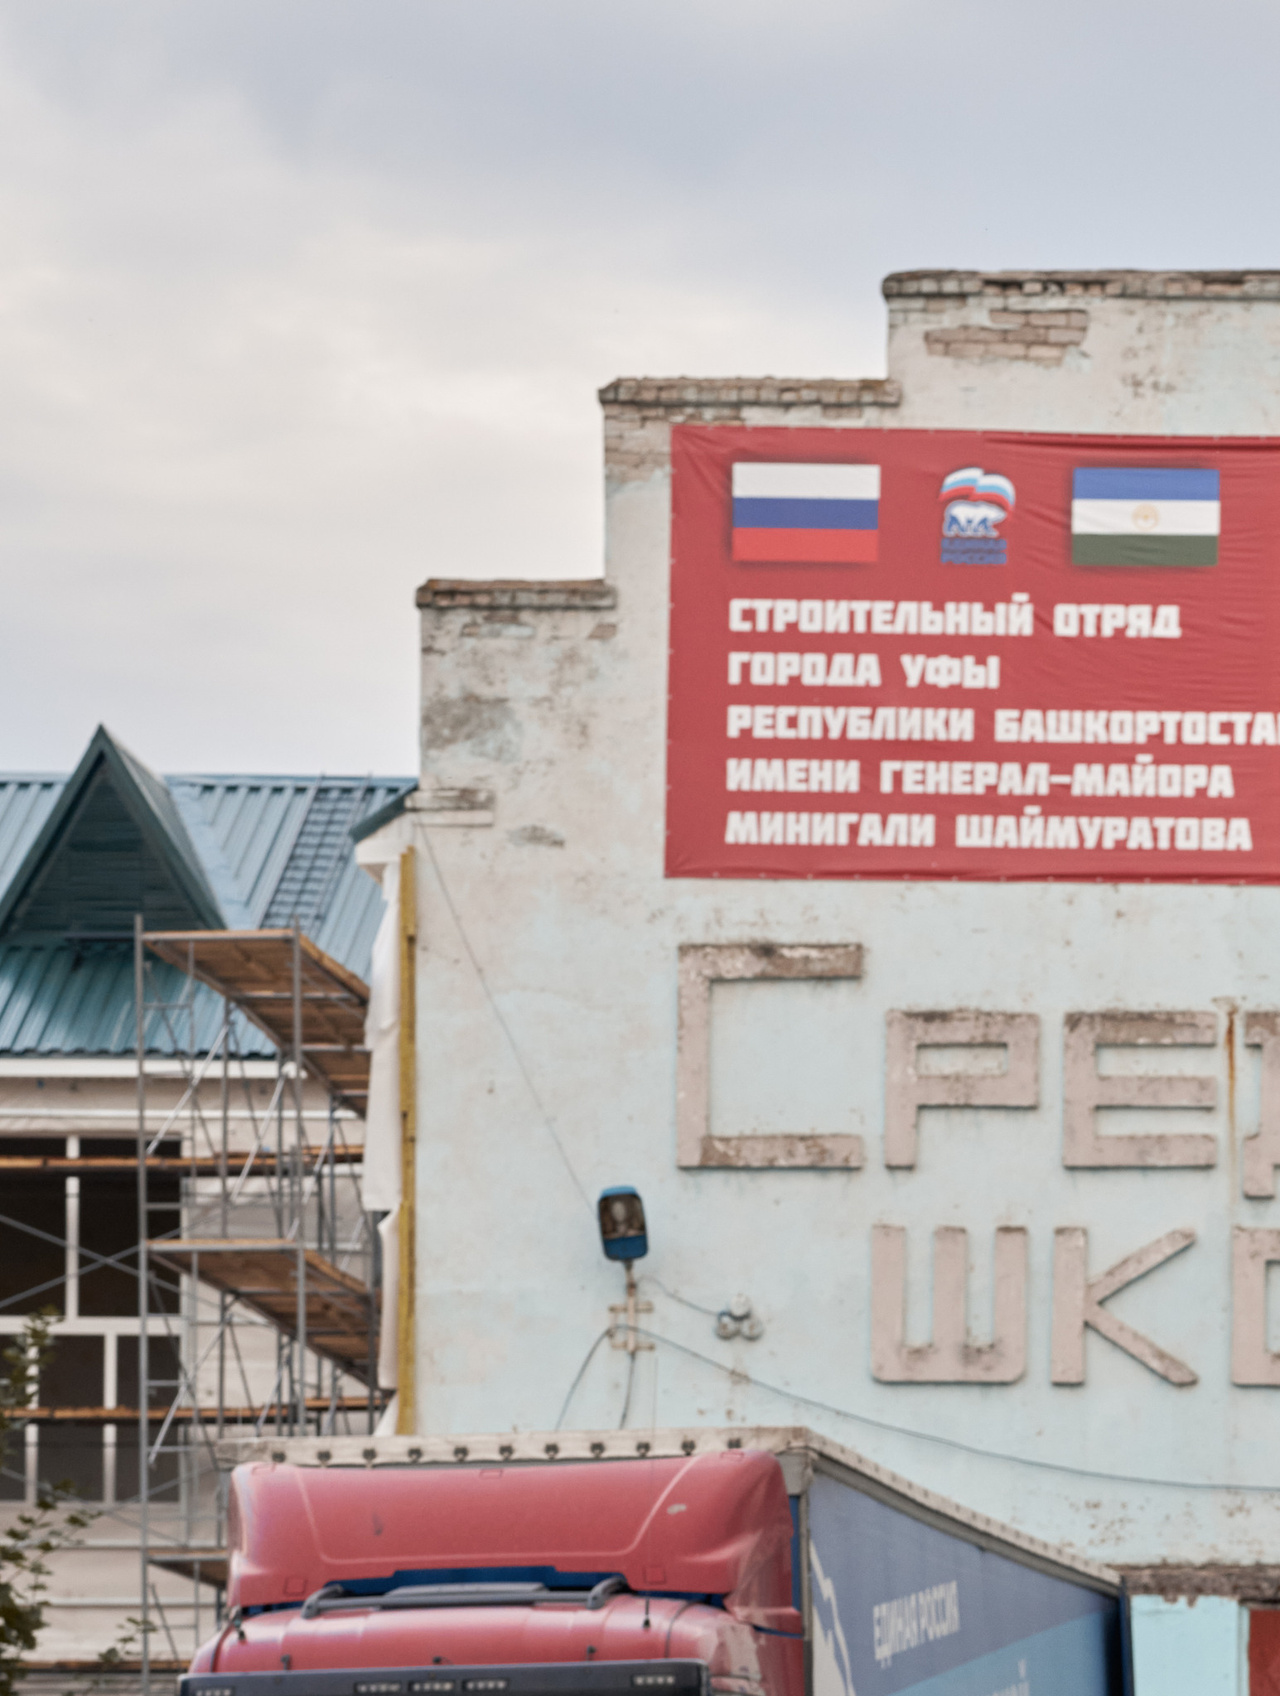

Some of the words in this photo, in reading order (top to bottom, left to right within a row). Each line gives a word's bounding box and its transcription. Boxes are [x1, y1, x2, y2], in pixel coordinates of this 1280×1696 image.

[729, 593, 1033, 637] СТРОИТЕЛЬНЫЙ
[1053, 604, 1182, 638] ОТРЯД
[728, 652, 881, 687] ГОРОДА
[901, 655, 999, 689] УФЫ
[727, 705, 974, 741] РЕСПУБЛИКИ
[726, 758, 860, 794] ИМЕНИ
[880, 754, 1234, 798] ГЕНЕРАЛ-МАЙОРА
[725, 811, 935, 847] МИНИГАЛИ
[955, 806, 1252, 851] ШАЙМУРАТОВА
